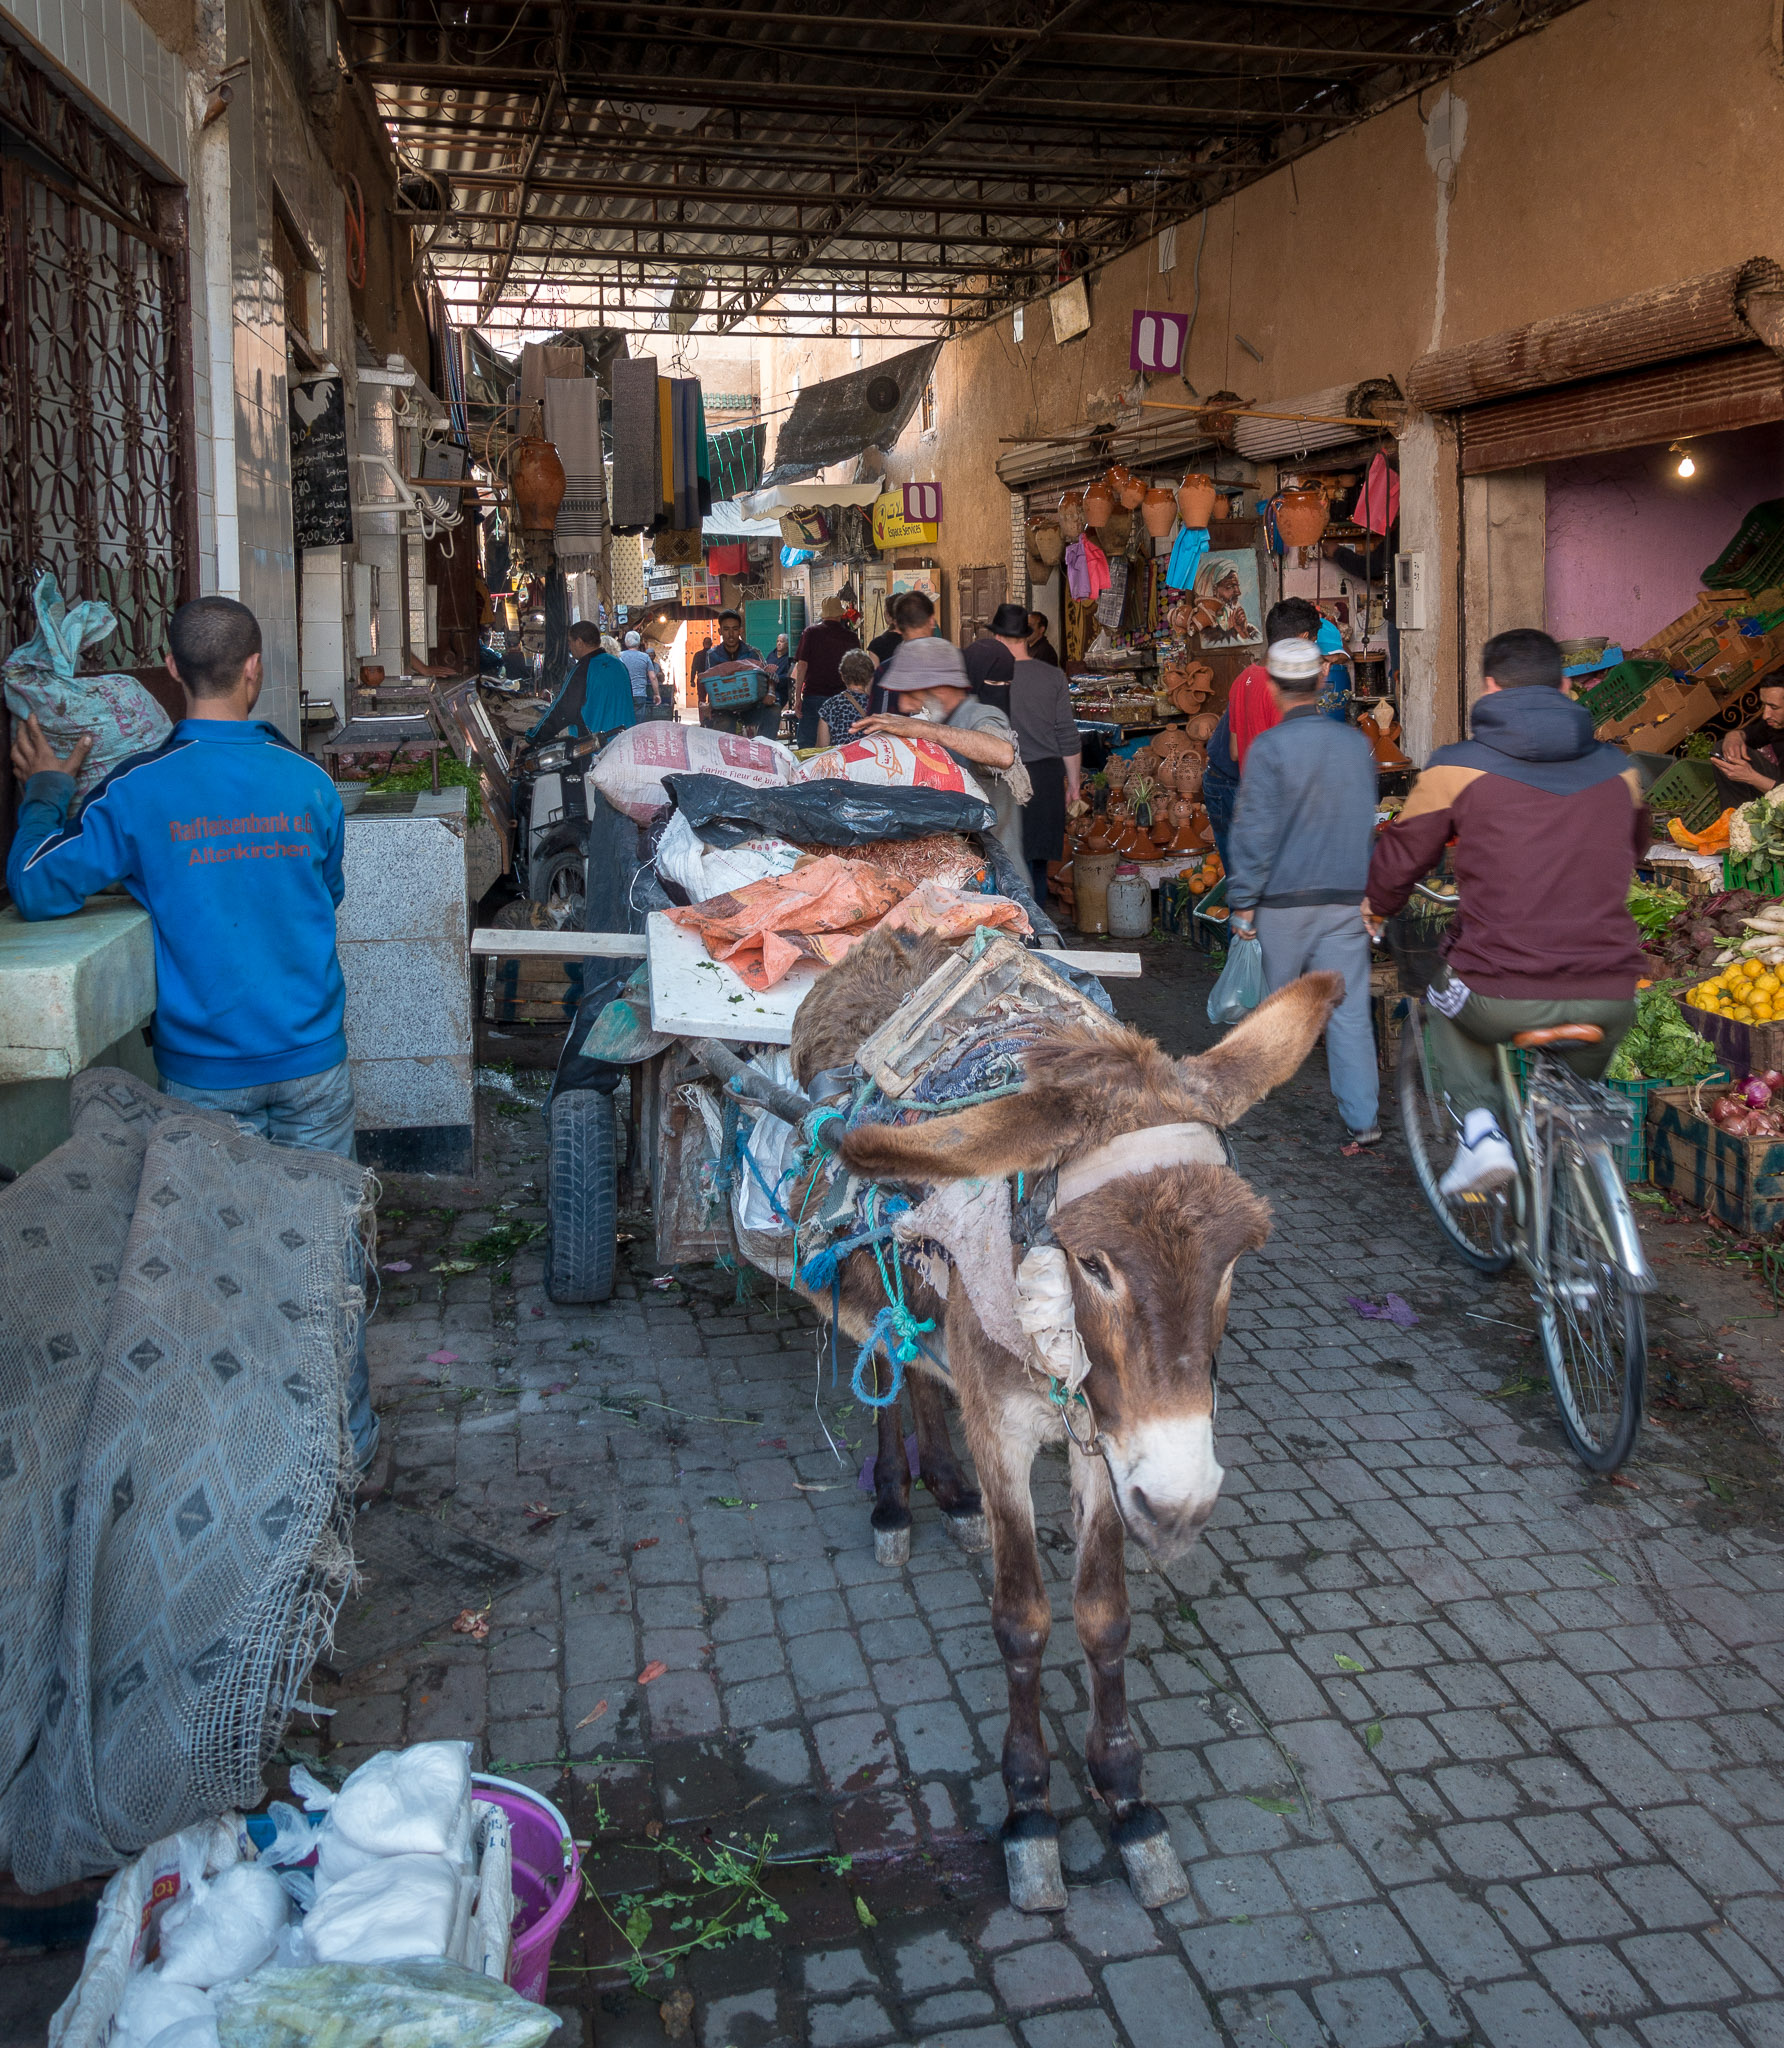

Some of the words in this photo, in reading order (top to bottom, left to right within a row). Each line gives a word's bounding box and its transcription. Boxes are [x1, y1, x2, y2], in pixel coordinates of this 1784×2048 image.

[888, 526, 902, 539] Espace
[902, 524, 922, 536] Services
[700, 764, 728, 776] Farine
[729, 770, 750, 780] Fleur
[752, 775, 763, 783] de
[169, 811, 290, 842] Raiffeisenbank
[188, 840, 311, 867] Altenkirchen
